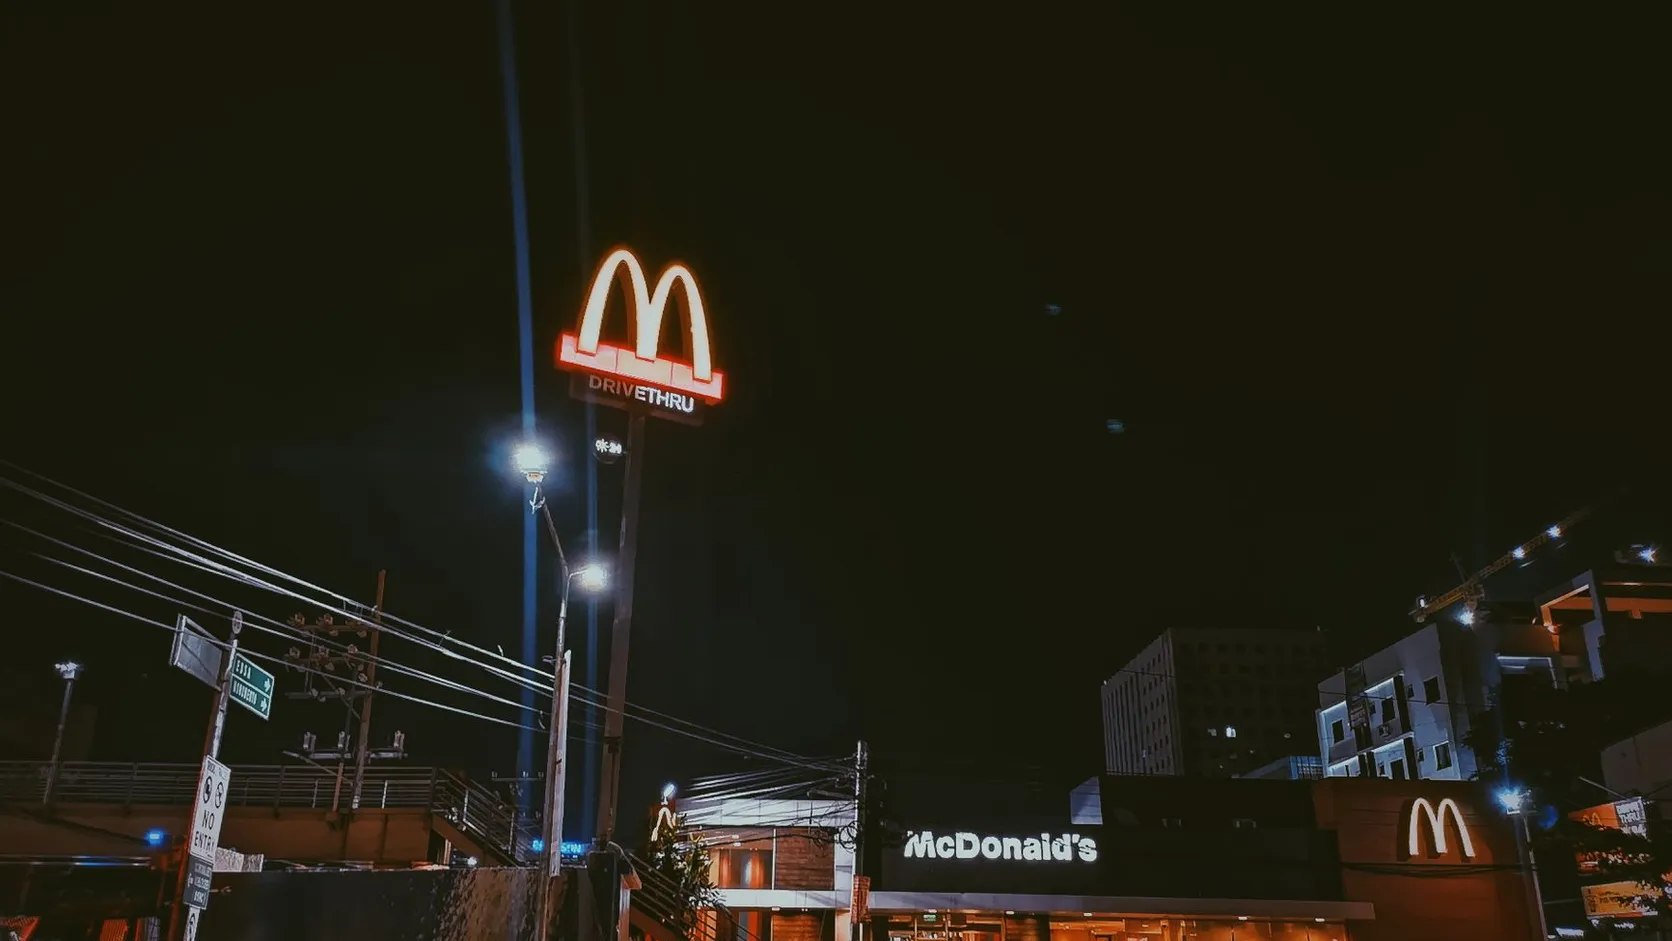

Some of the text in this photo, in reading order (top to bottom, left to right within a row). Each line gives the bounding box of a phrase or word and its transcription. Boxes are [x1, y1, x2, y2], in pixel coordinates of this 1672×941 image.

[202, 809, 215, 830] NO
[194, 831, 215, 852] ENTRY
[904, 831, 1098, 861] McDonald's
